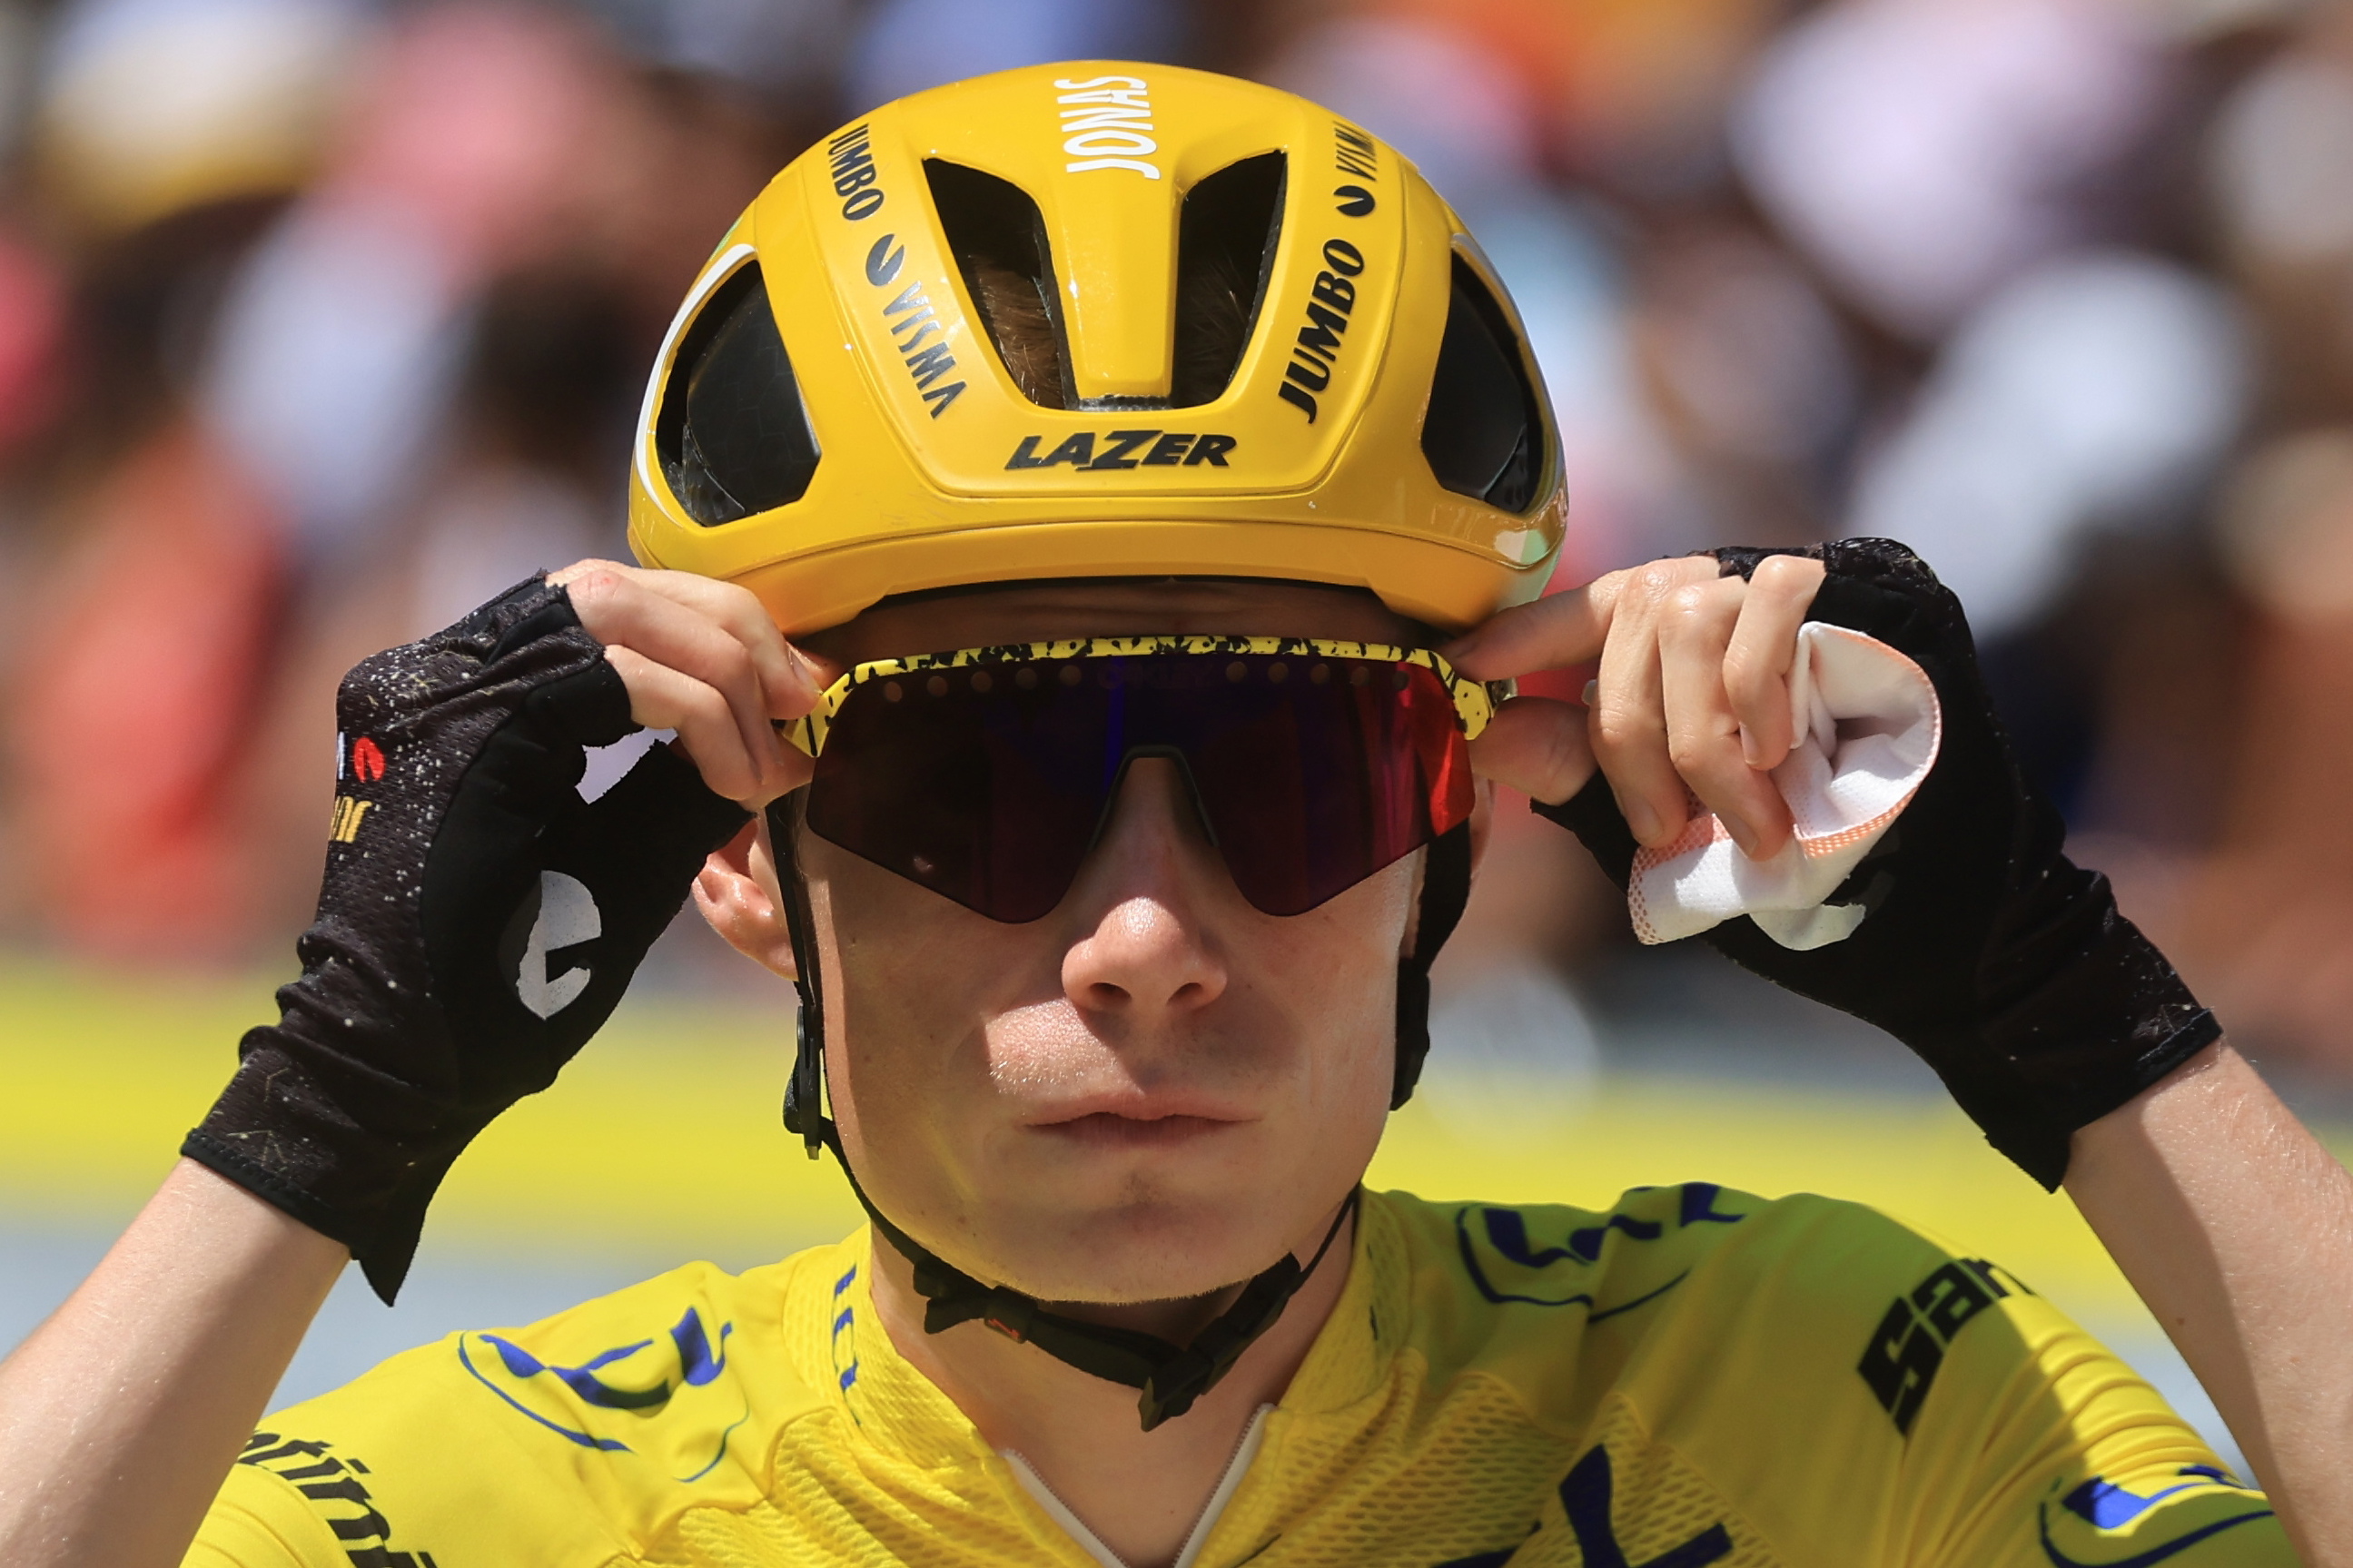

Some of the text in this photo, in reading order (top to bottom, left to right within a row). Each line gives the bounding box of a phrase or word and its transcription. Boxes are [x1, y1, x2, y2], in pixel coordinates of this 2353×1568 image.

[1053, 75, 1161, 180] JONAS
[827, 122, 966, 419] JUMBO VISMA
[1278, 238, 1365, 424] JUMBO
[1003, 429, 1237, 471] LAZER
